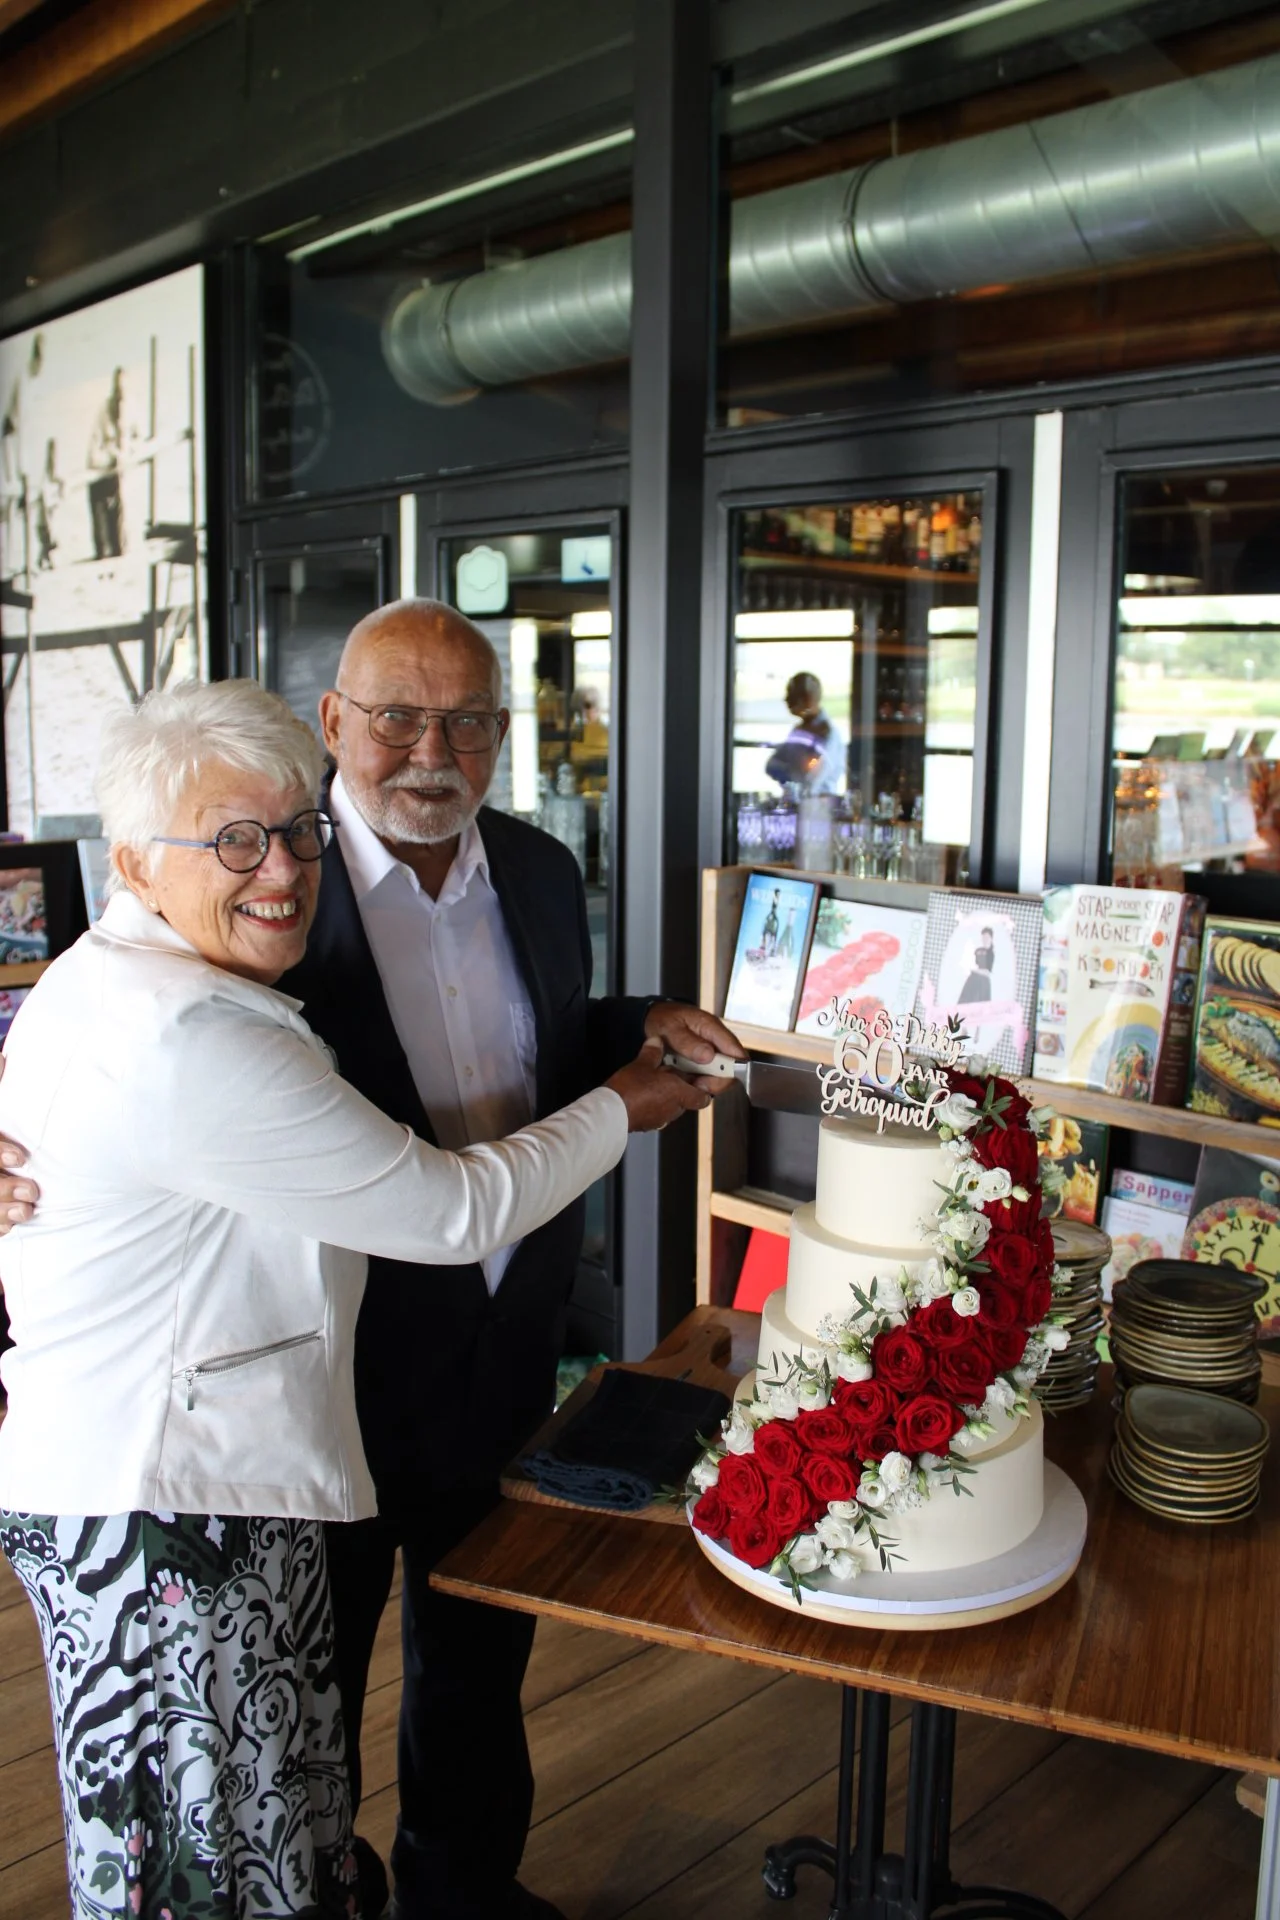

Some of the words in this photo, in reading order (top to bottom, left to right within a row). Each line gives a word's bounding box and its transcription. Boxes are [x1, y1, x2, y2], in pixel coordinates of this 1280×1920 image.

[1078, 895, 1113, 919] STAP
[1144, 899, 1175, 925] STAP
[817, 996, 870, 1033] Nico
[869, 1009, 893, 1039] &
[833, 1031, 904, 1088] 60
[902, 1063, 950, 1088] JAAR
[816, 1062, 951, 1133] Getrouwd
